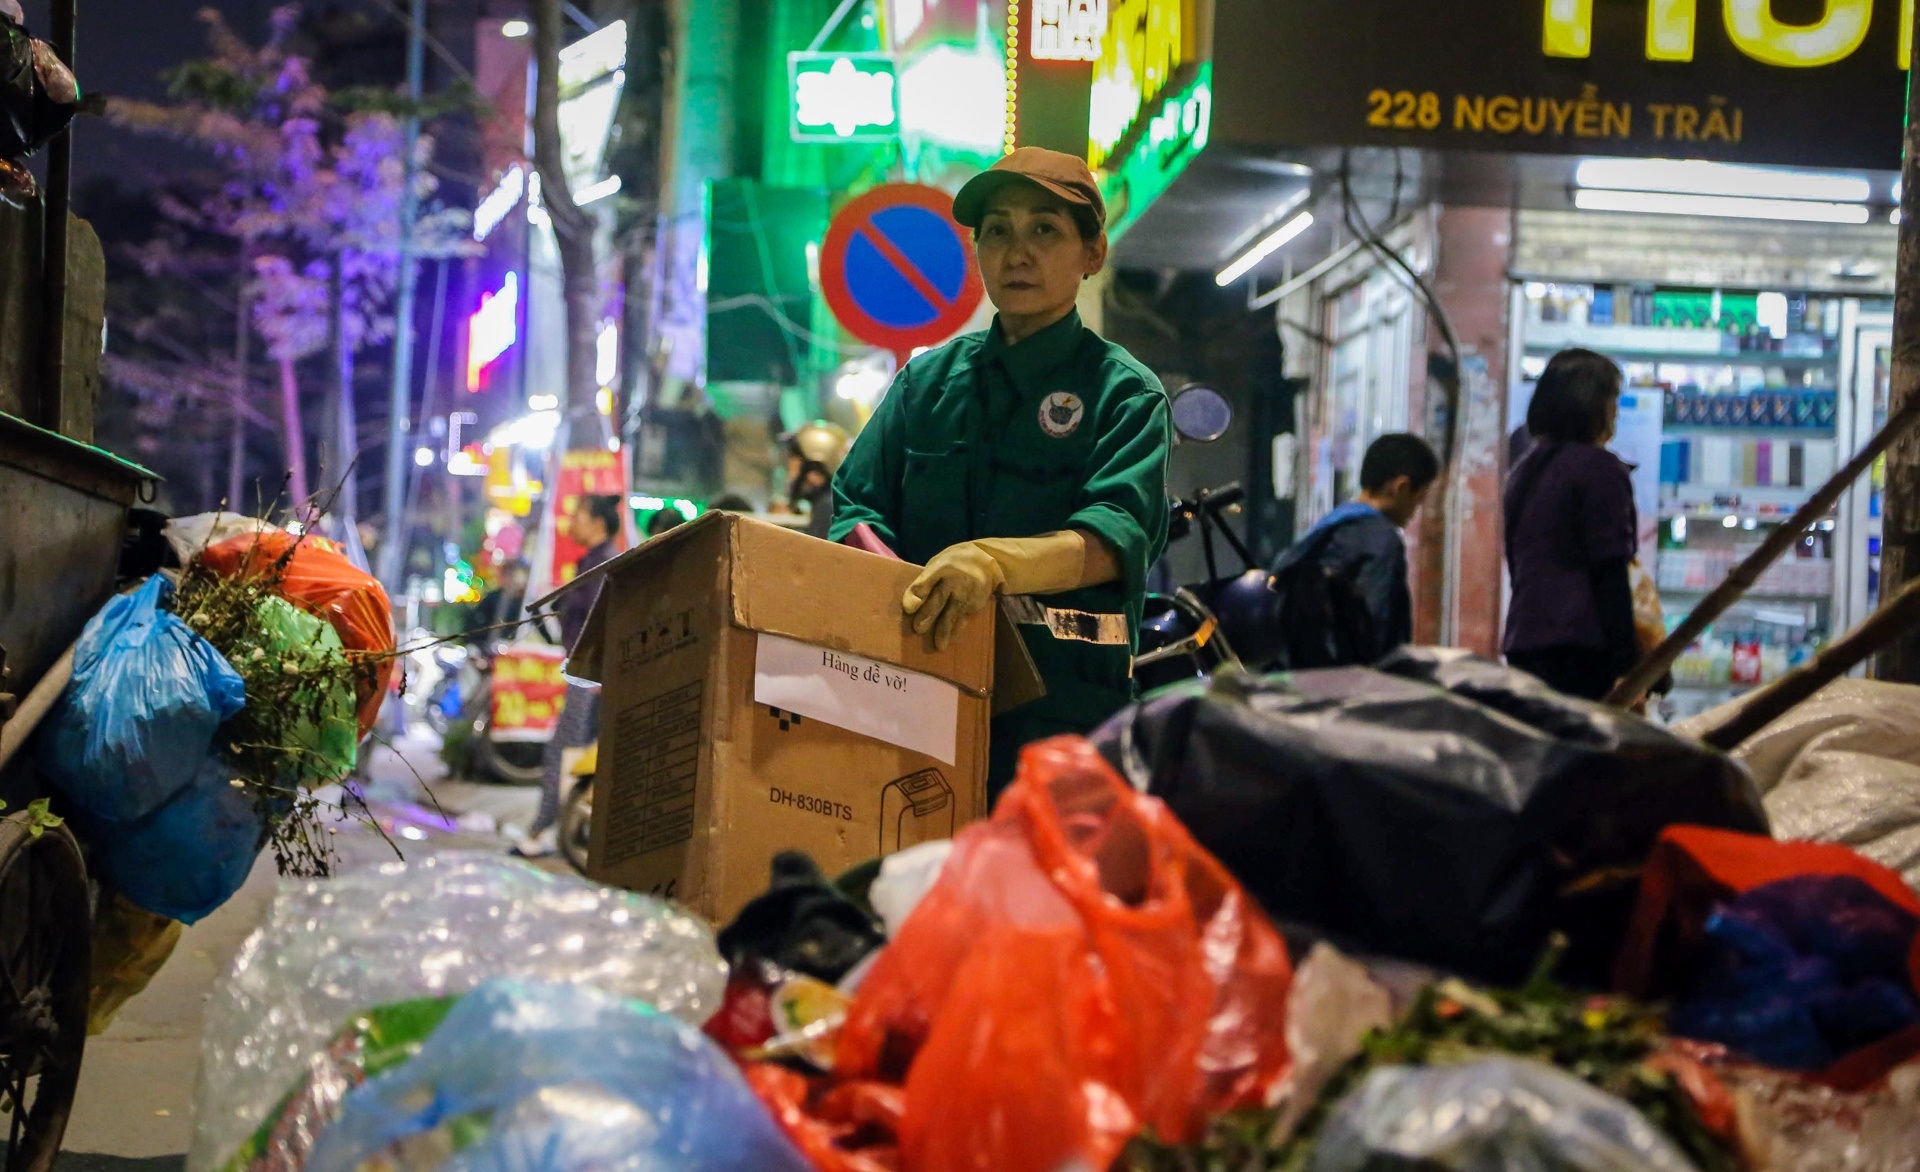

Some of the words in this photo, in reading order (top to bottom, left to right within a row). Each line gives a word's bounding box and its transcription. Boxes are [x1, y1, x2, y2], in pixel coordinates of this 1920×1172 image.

[1367, 88, 1441, 130] 228
[1453, 82, 1632, 139] NGUYỄN
[1648, 95, 1743, 143] TRÃI
[822, 651, 859, 681] Hàng
[863, 664, 880, 684] dễ
[885, 675, 907, 692] vỡ!
[770, 787, 852, 821] DH-830BTS
